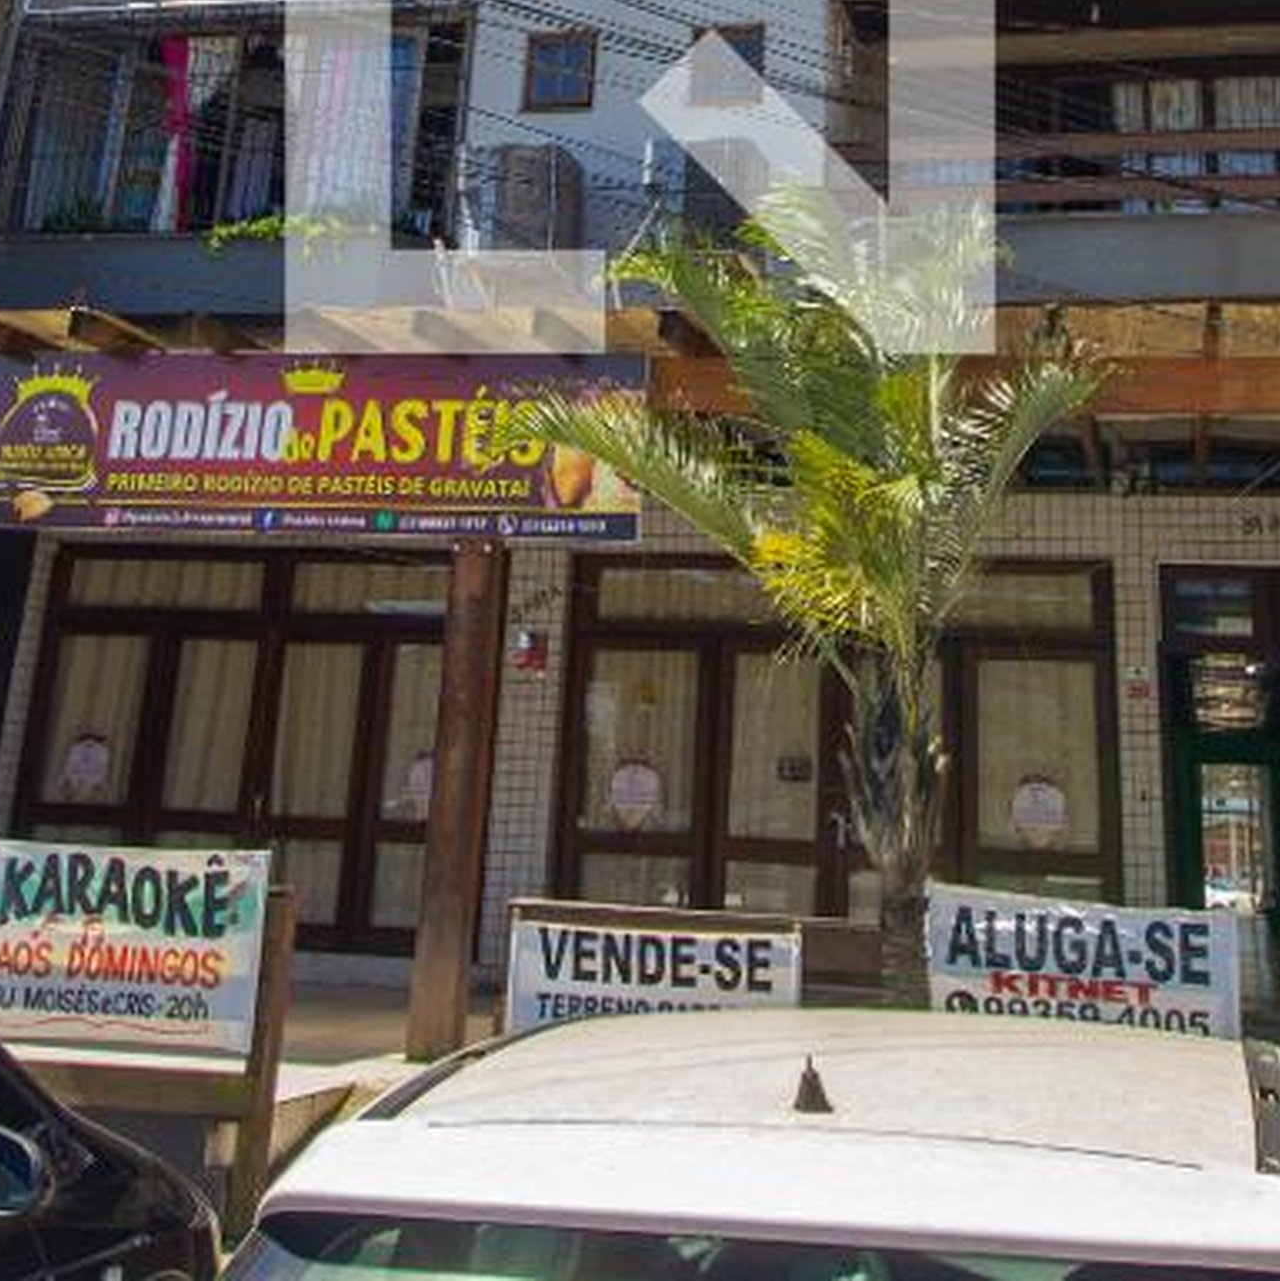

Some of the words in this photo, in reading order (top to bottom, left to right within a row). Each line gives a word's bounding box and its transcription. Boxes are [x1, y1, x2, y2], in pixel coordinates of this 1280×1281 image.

[107, 388, 294, 461] RODÍZIO
[106, 472, 199, 493] PRIMEIRO
[537, 925, 775, 993] VENDE-SE
[945, 905, 1212, 986] ALUGA-SE
[987, 970, 1161, 1006] KITNET
